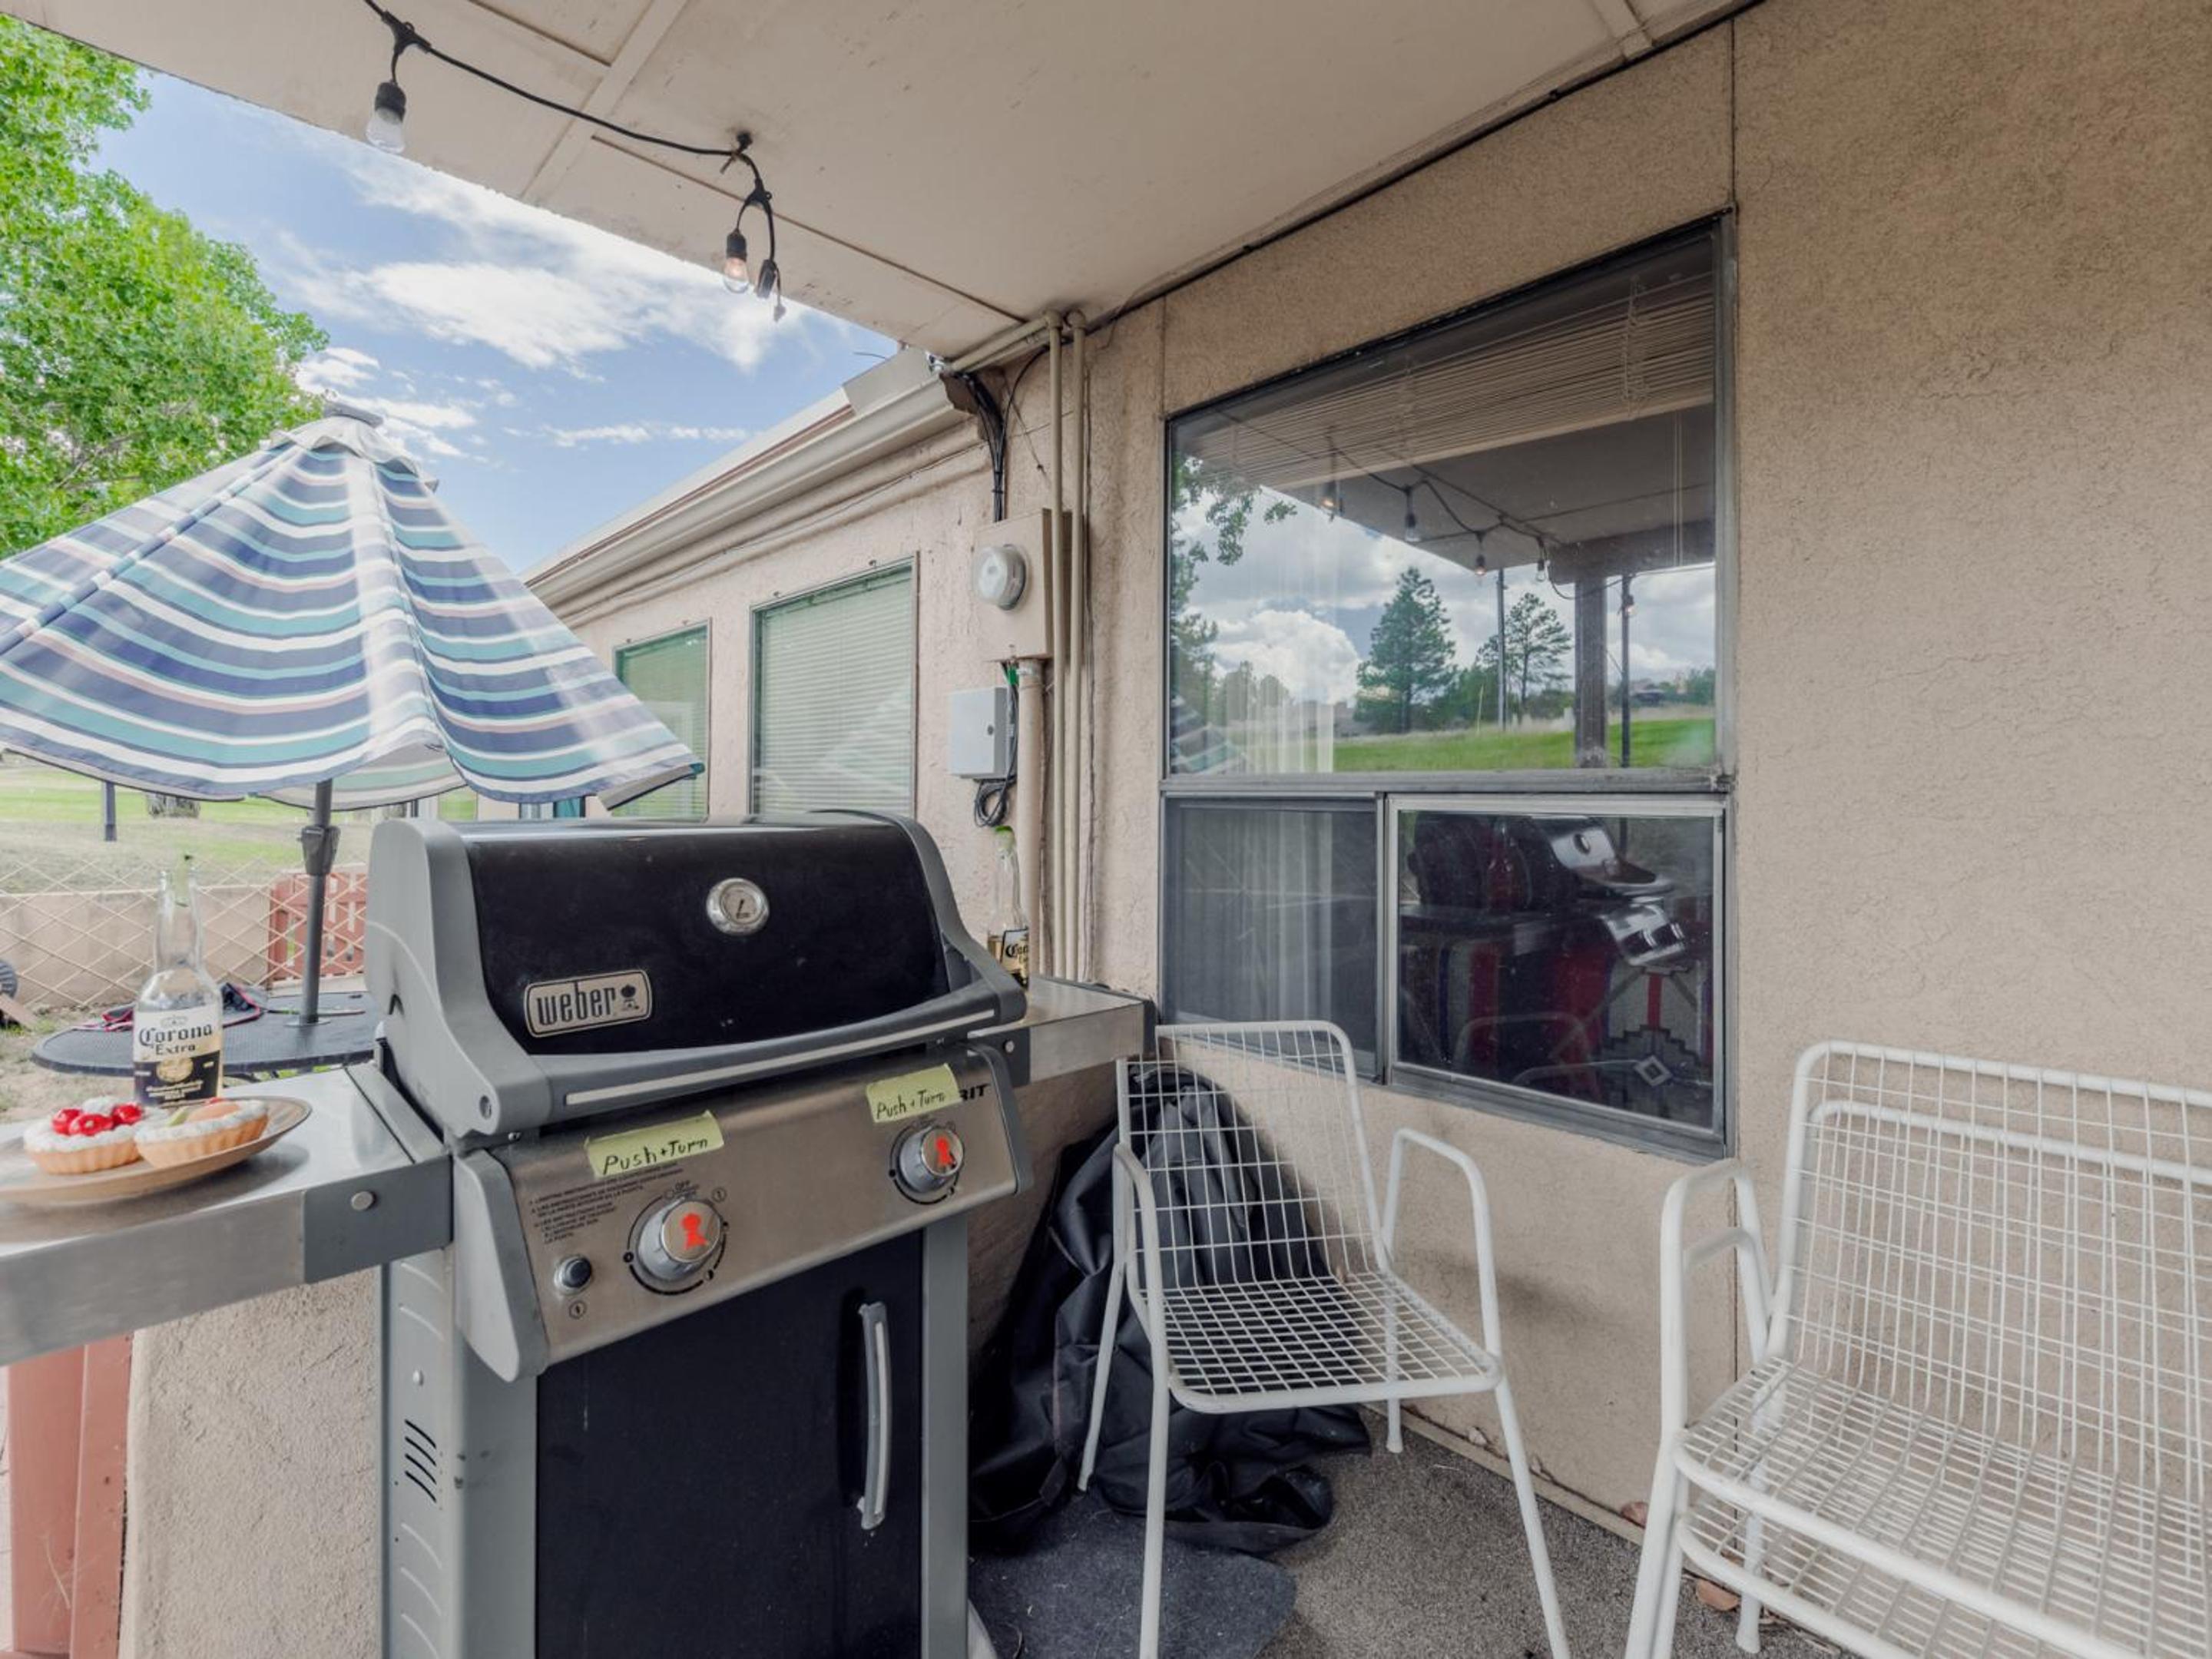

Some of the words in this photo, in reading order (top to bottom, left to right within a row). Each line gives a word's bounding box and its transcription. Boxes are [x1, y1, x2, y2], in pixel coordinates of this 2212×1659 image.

[535, 982, 616, 1025] weber
[139, 1024, 212, 1047] Corona
[156, 1044, 195, 1055] Extra
[876, 1094, 907, 1119] Push
[917, 1088, 946, 1108] Turn
[603, 1146, 657, 1175] Push
[668, 1138, 708, 1157] Turn
